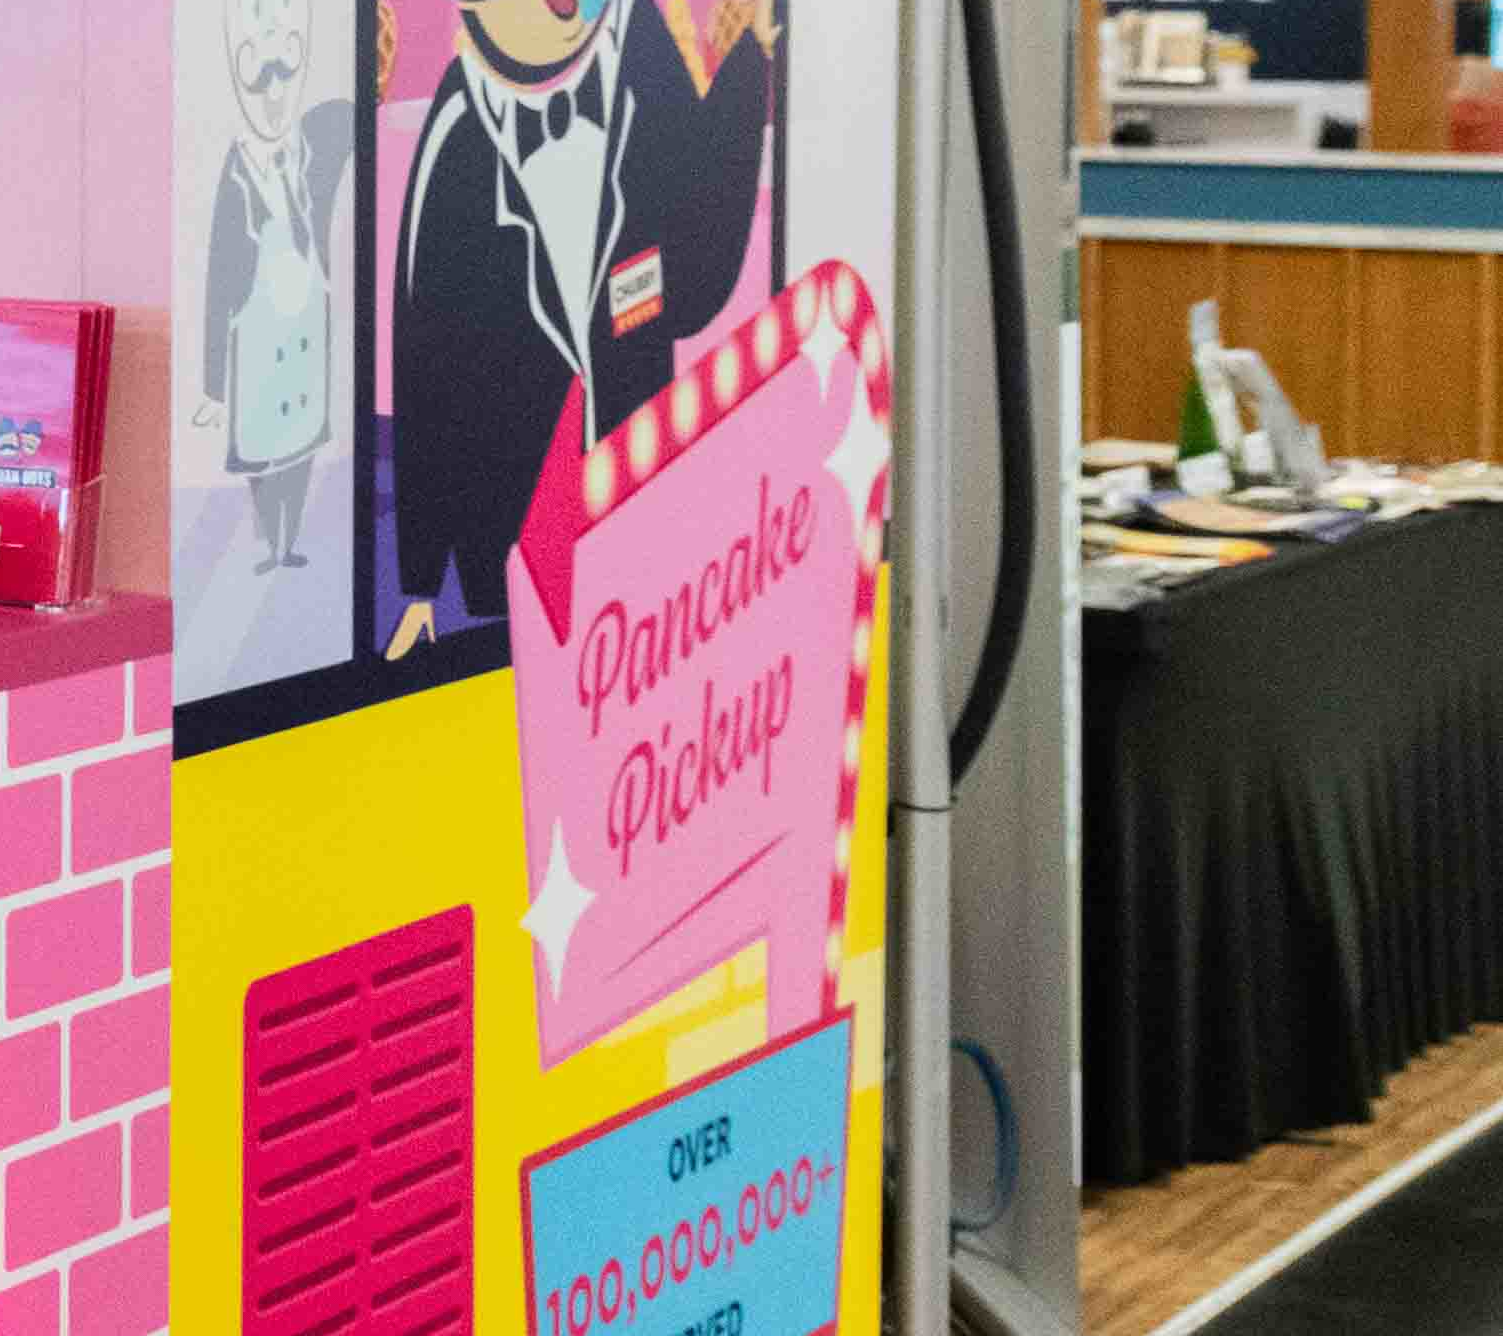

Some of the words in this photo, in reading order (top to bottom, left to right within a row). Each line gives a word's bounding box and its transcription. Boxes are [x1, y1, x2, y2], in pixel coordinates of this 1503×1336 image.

[577, 473, 813, 739] Pancake
[607, 654, 795, 878] Pickup
[668, 1115, 732, 1182] OVER
